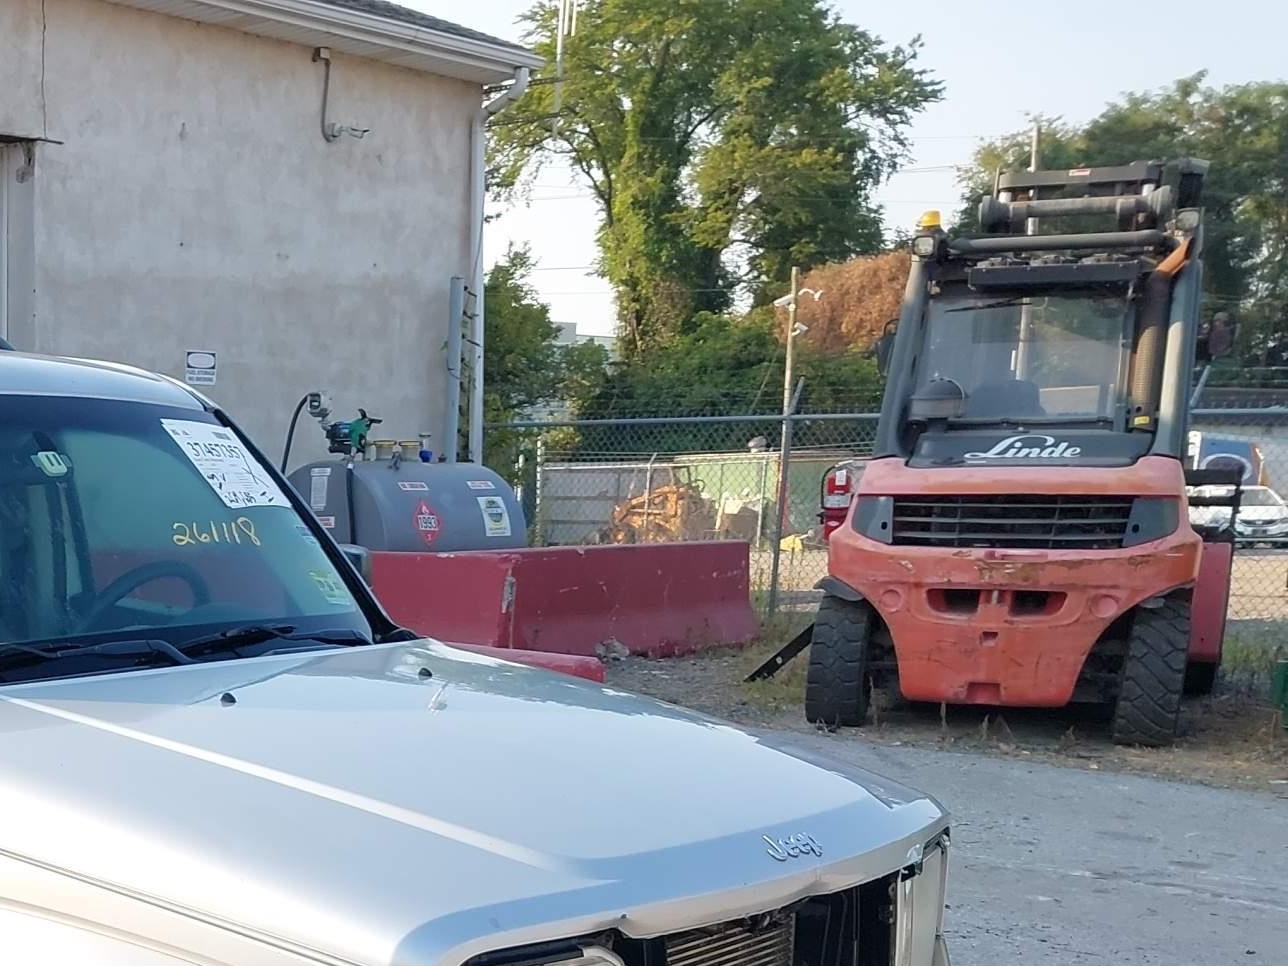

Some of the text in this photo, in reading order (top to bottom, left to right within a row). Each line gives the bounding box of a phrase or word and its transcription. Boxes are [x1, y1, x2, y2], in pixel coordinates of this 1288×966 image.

[963, 434, 1081, 459] Linde
[173, 517, 261, 546] 261118
[761, 831, 824, 863] Jeep
